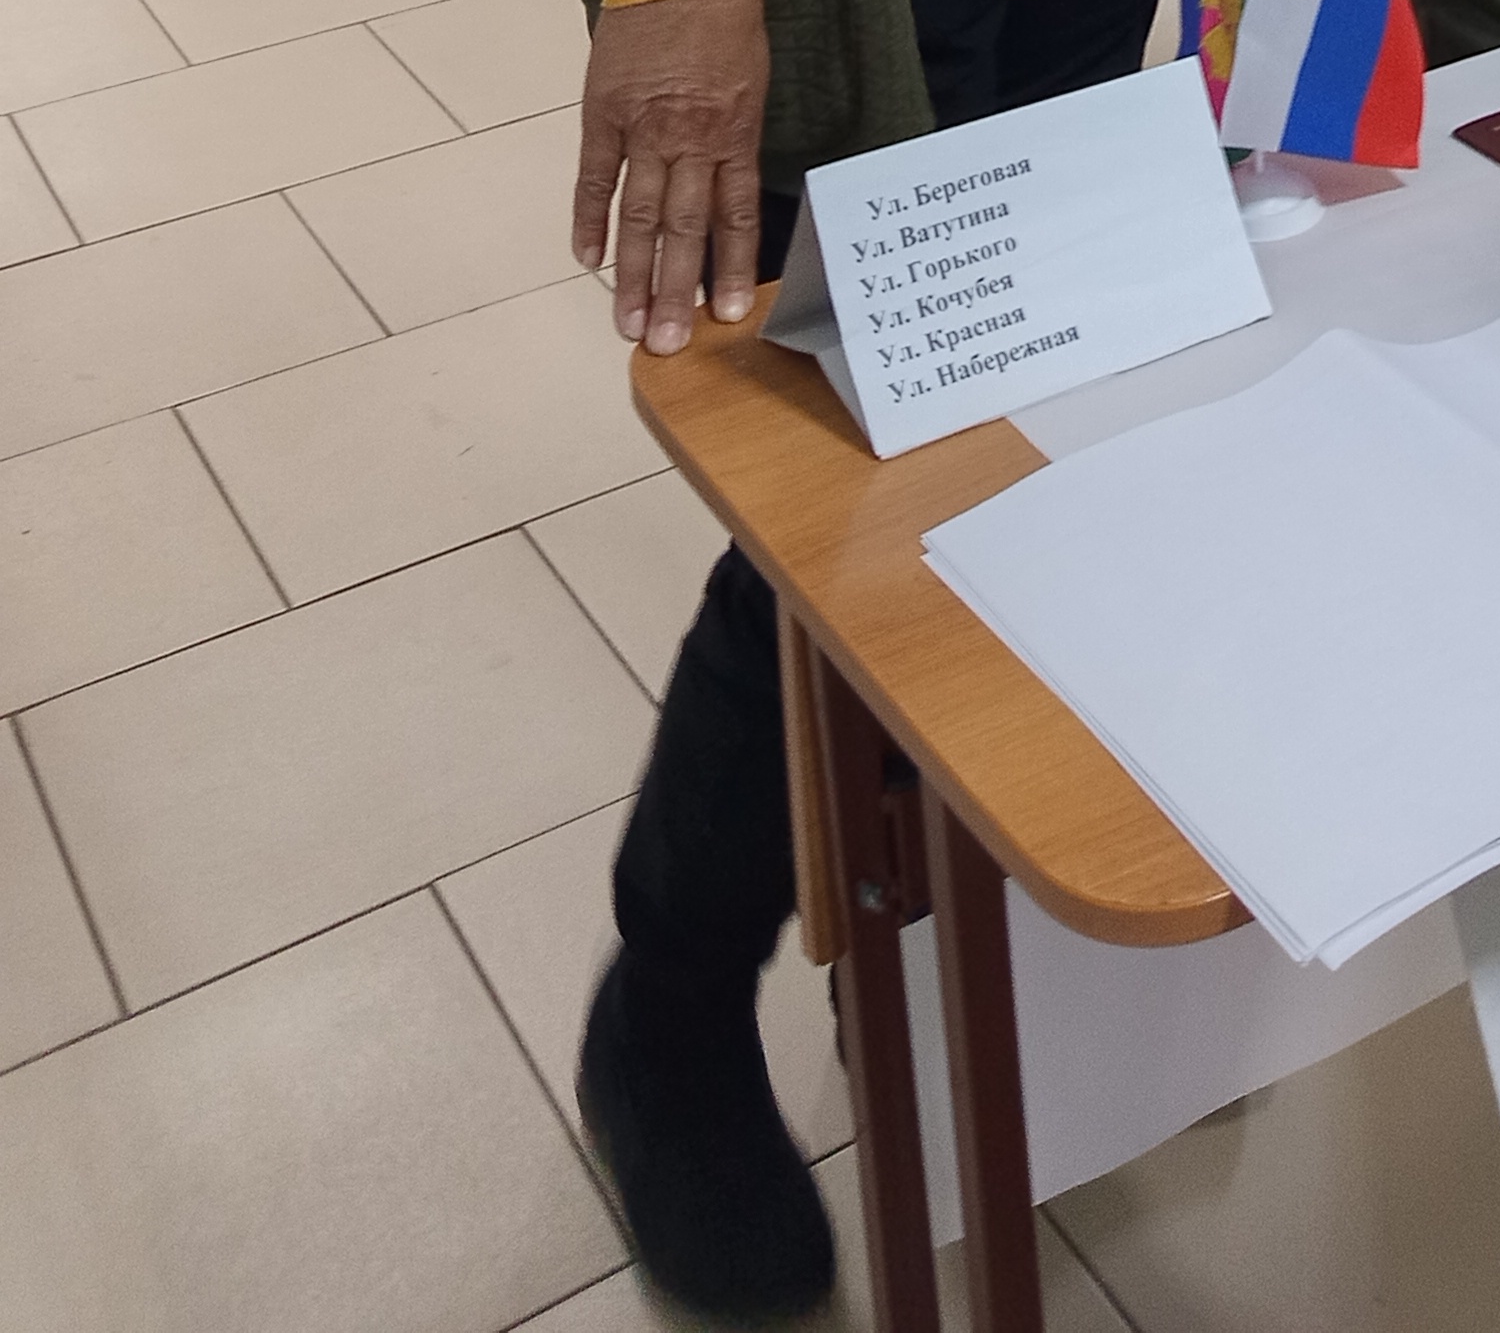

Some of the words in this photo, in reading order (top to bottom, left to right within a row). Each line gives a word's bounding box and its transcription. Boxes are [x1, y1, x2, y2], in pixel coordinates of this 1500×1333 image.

[865, 197, 909, 221] Ул.
[913, 158, 1032, 207] Береговая
[851, 239, 894, 263] Ул.
[898, 201, 1010, 249] Ватутина
[859, 274, 902, 299] Ул.
[907, 236, 1017, 284] Горького
[867, 309, 911, 334] Ул.
[916, 273, 1015, 319] Кочубея
[876, 344, 921, 369] Ул.
[925, 306, 1027, 352] Красная
[887, 379, 932, 404] Ул.
[936, 325, 1080, 388] Набережная
